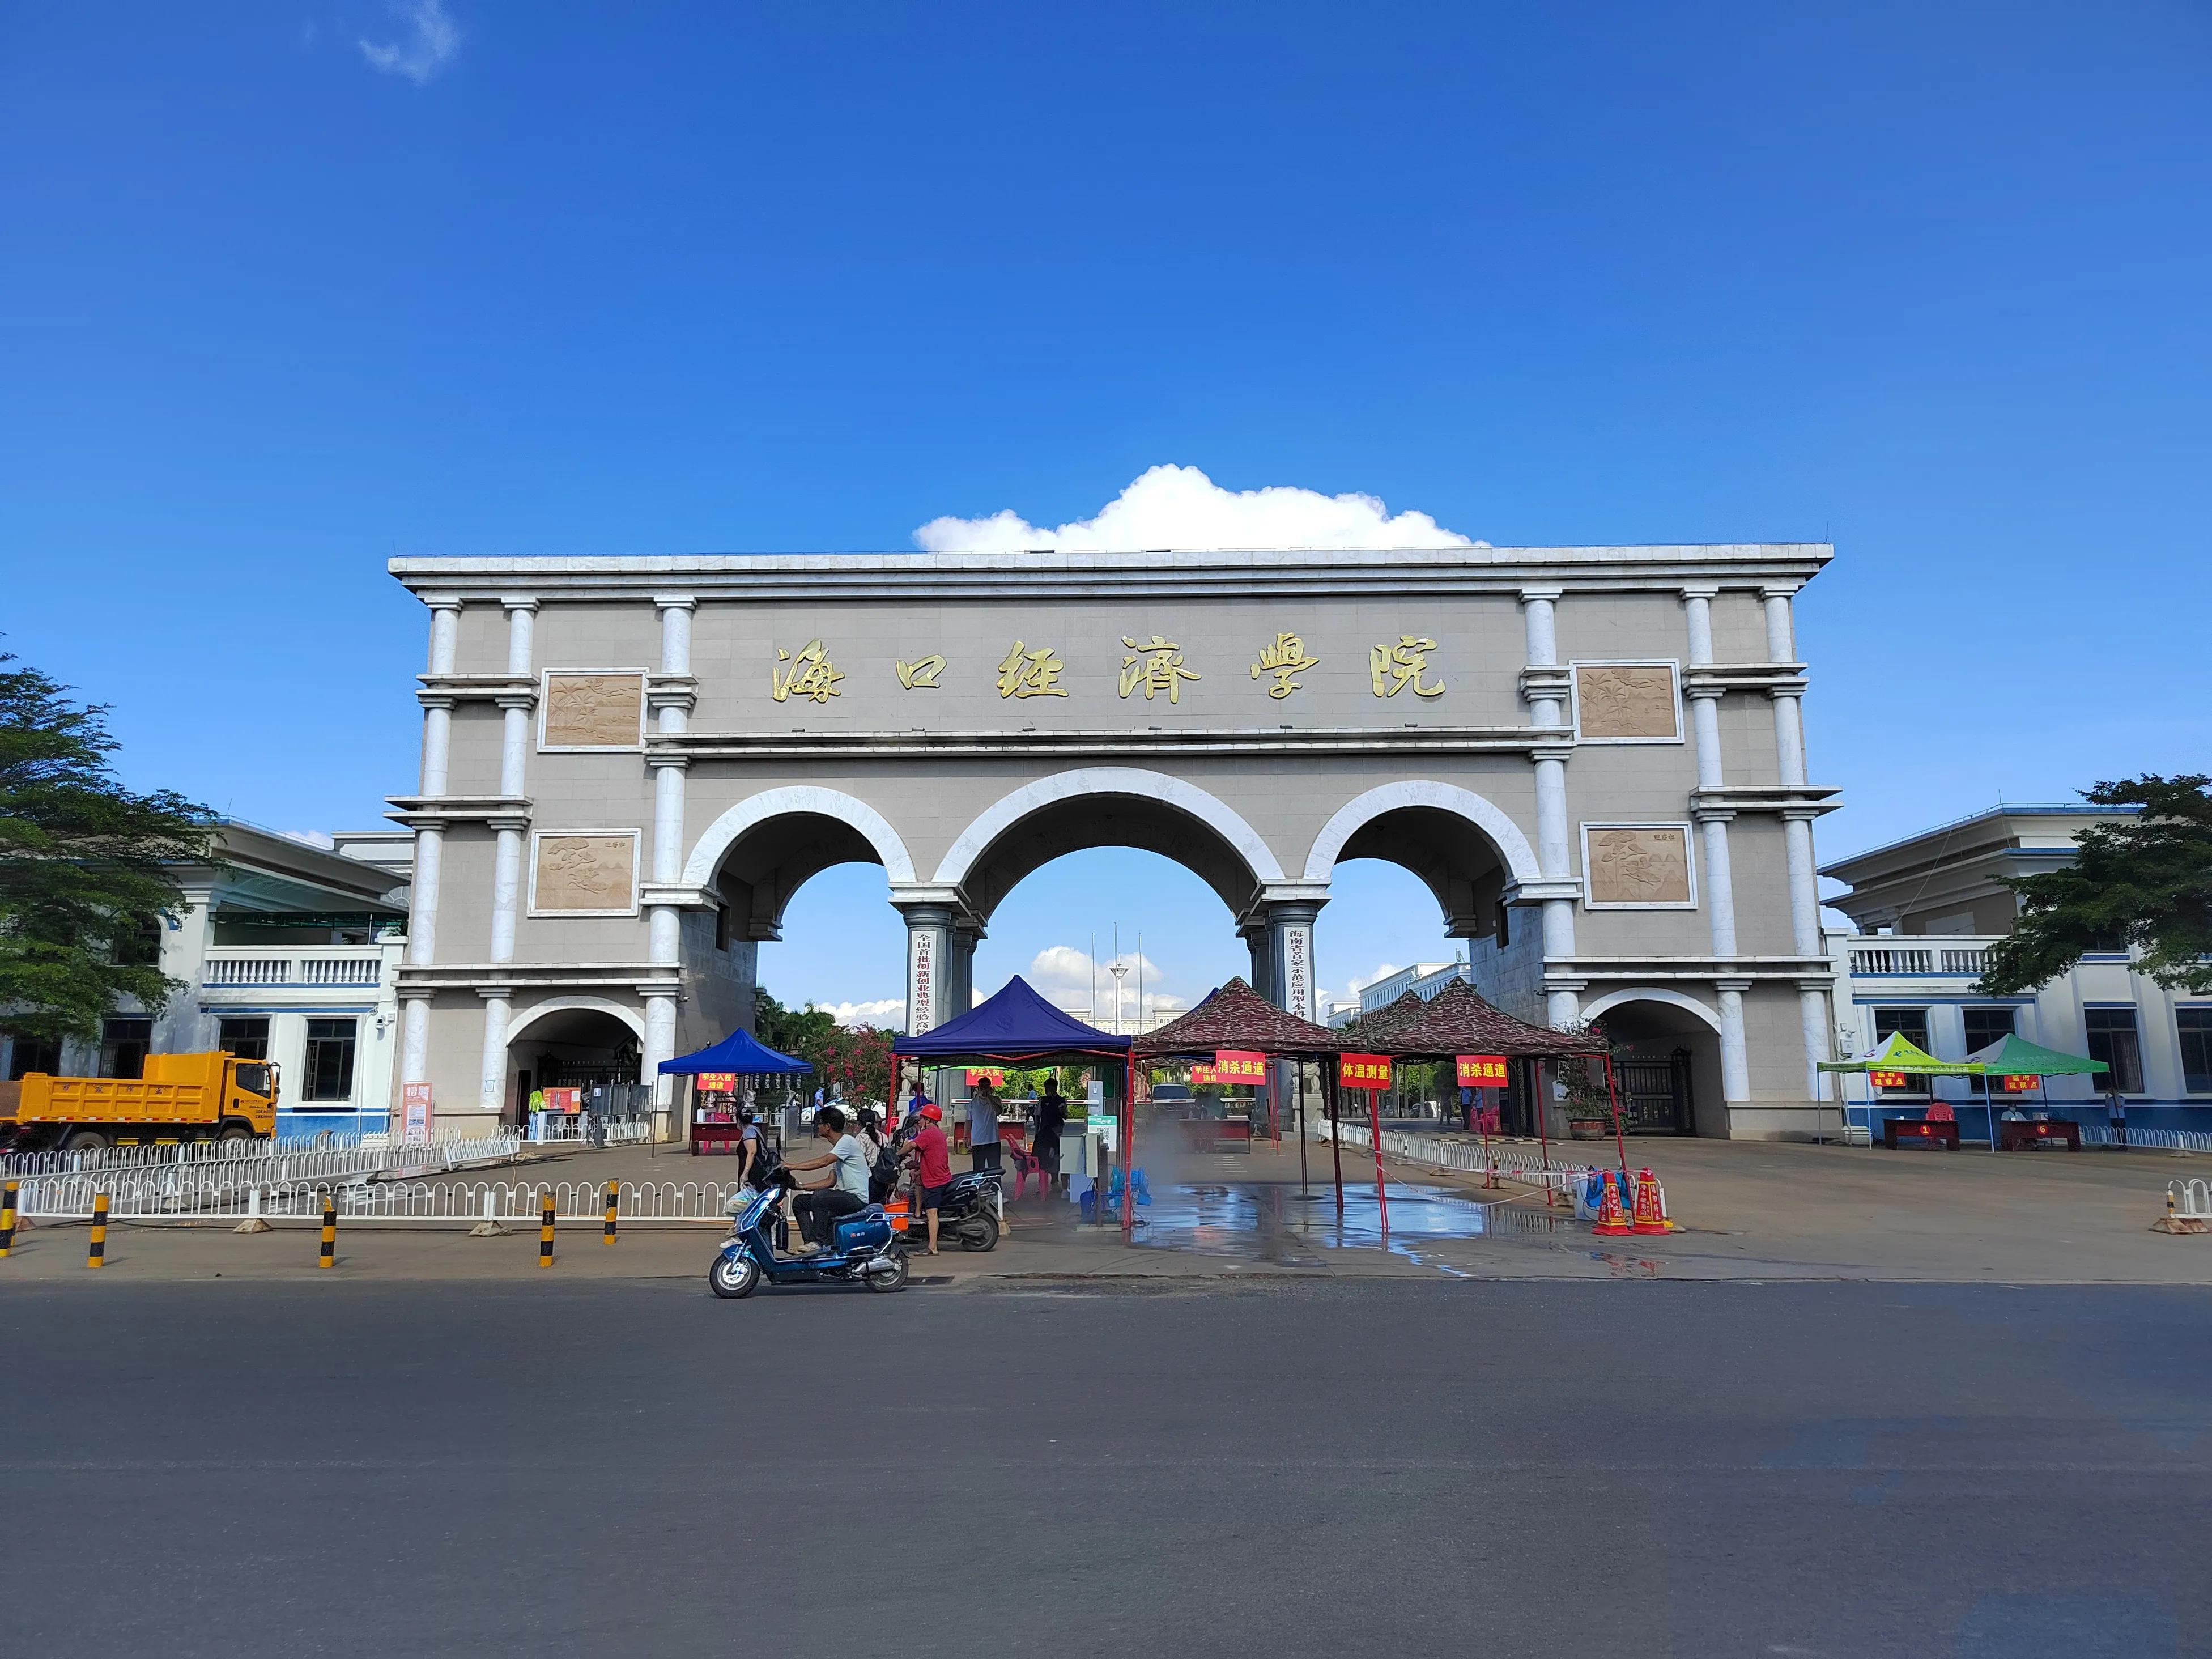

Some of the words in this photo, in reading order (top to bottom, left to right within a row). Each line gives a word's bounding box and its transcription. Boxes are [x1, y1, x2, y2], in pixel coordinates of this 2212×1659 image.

[1289, 930, 1306, 1018] 海南省首家示范应用型本科
[915, 934, 931, 1036] 全国首批创新创业典型经验高校
[1218, 1060, 1264, 1076] 消杀通道
[1342, 1062, 1389, 1080] 体温测量
[1459, 1062, 1506, 1078] 消杀通道
[702, 1073, 733, 1082] 学生入校
[2040, 1125, 2046, 1133] 6
